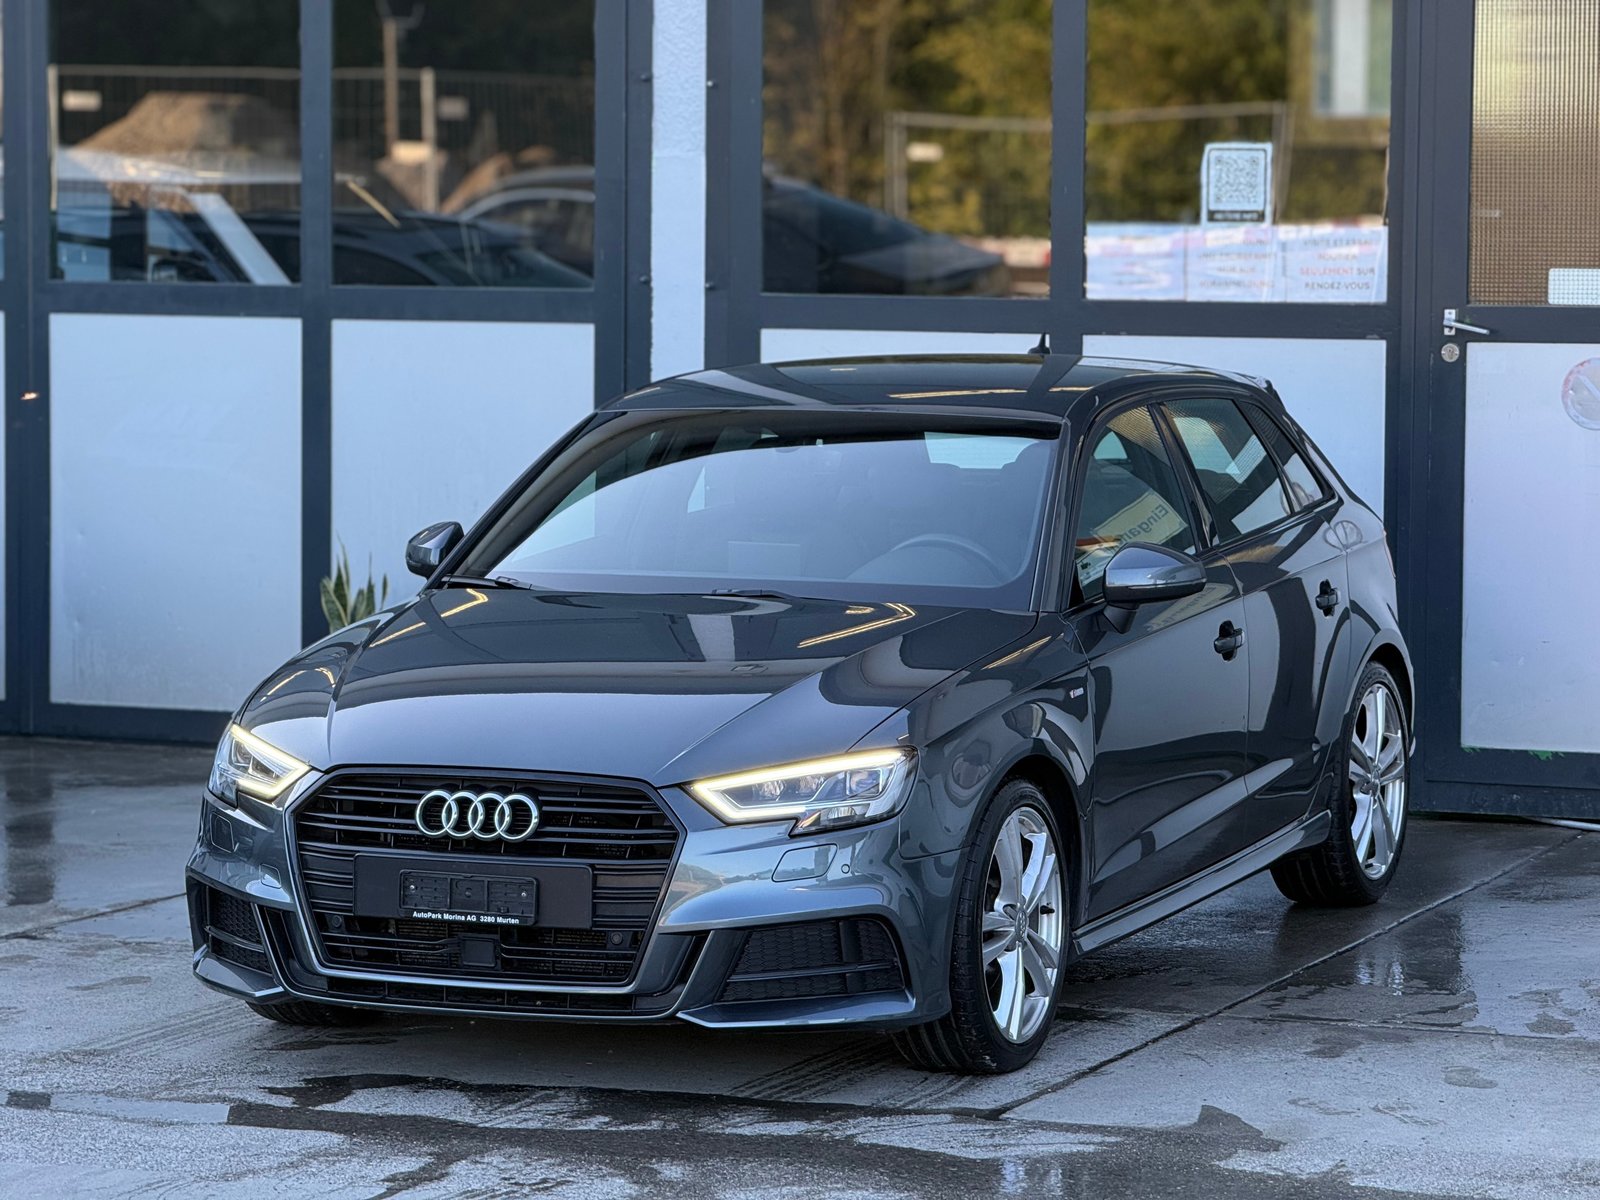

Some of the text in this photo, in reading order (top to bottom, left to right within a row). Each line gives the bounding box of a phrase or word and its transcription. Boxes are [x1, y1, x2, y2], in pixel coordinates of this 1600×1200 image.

[1300, 266, 1376, 276] SEULEMENT SUR
[1304, 281, 1371, 290] RENDEZ-VOUS
[412, 910, 442, 919] AutoPark
[466, 914, 477, 922] AG
[479, 915, 496, 923] 3280
[496, 916, 520, 925] Murten
